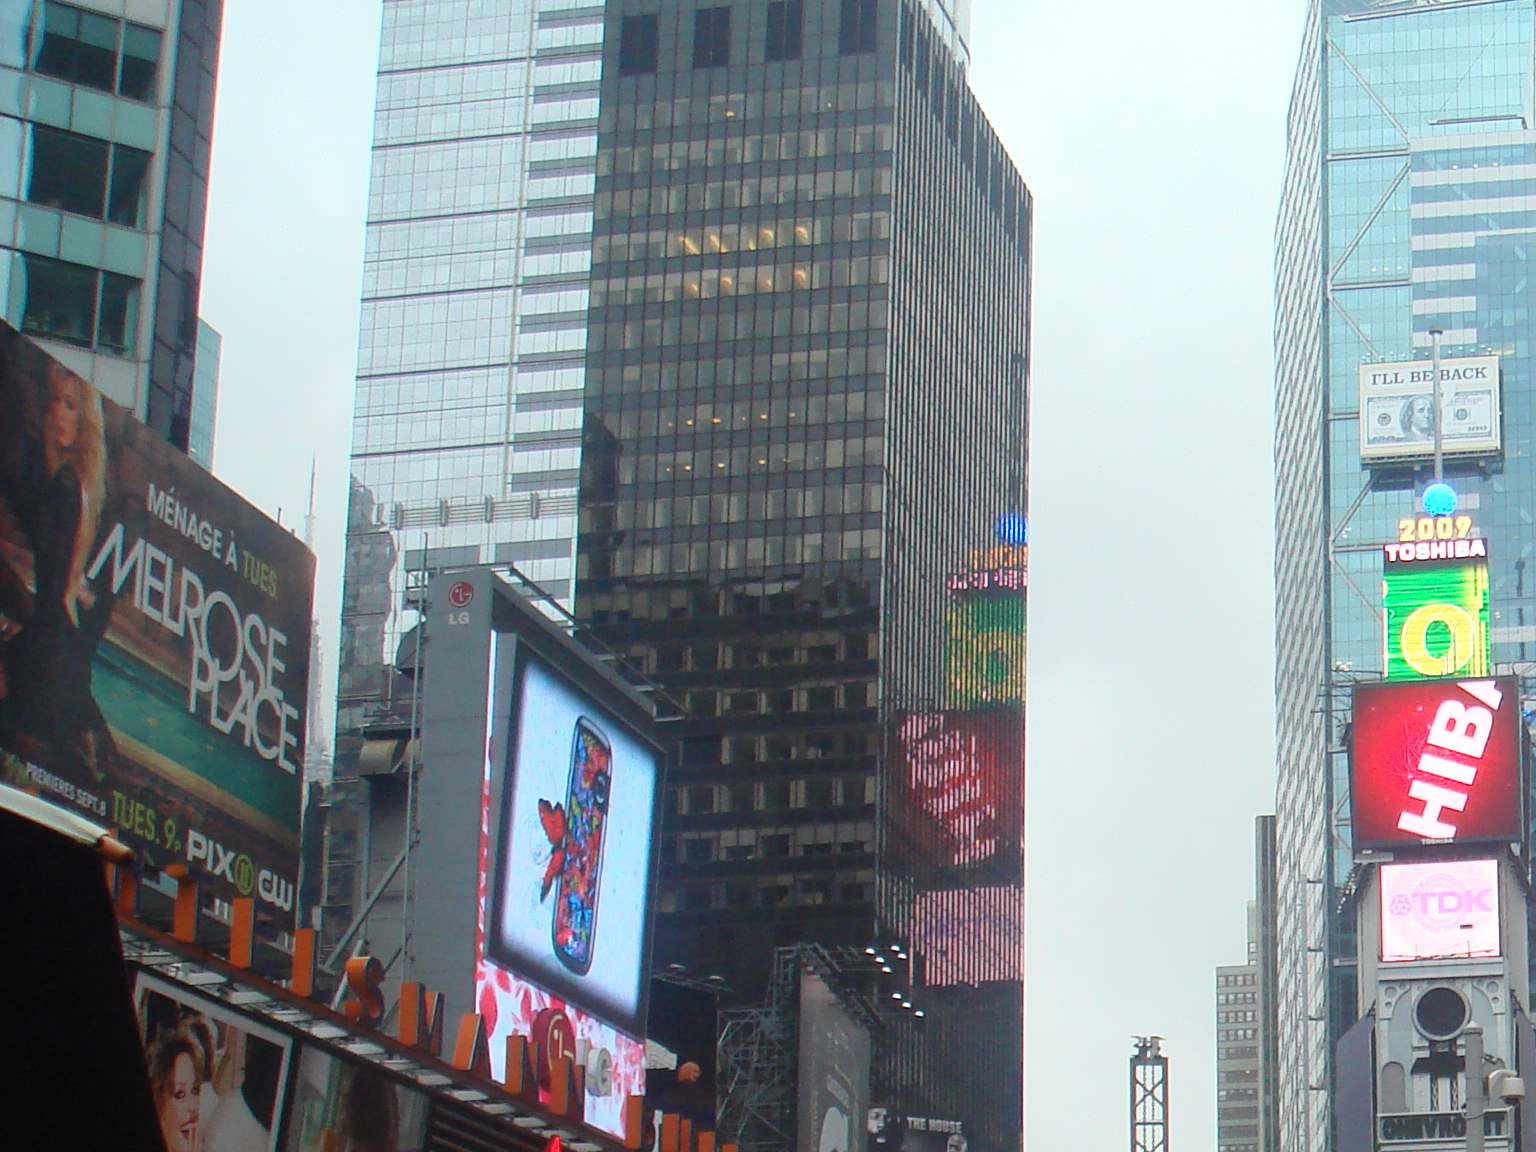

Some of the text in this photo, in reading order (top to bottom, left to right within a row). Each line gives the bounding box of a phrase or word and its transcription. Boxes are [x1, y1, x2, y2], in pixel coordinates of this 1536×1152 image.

[1371, 366, 1488, 386] I'LL BE BACK
[147, 484, 223, 561] MÉNAGE
[1398, 516, 1473, 542] 2009
[1385, 538, 1486, 562] TOSHIBA
[87, 522, 288, 698] MELROSE
[449, 612, 470, 626] LG
[189, 645, 298, 775] PLACE
[1411, 888, 1493, 915] TDK
[906, 1117, 927, 1131] THE
[1383, 1111, 1506, 1140] CHEVROT
